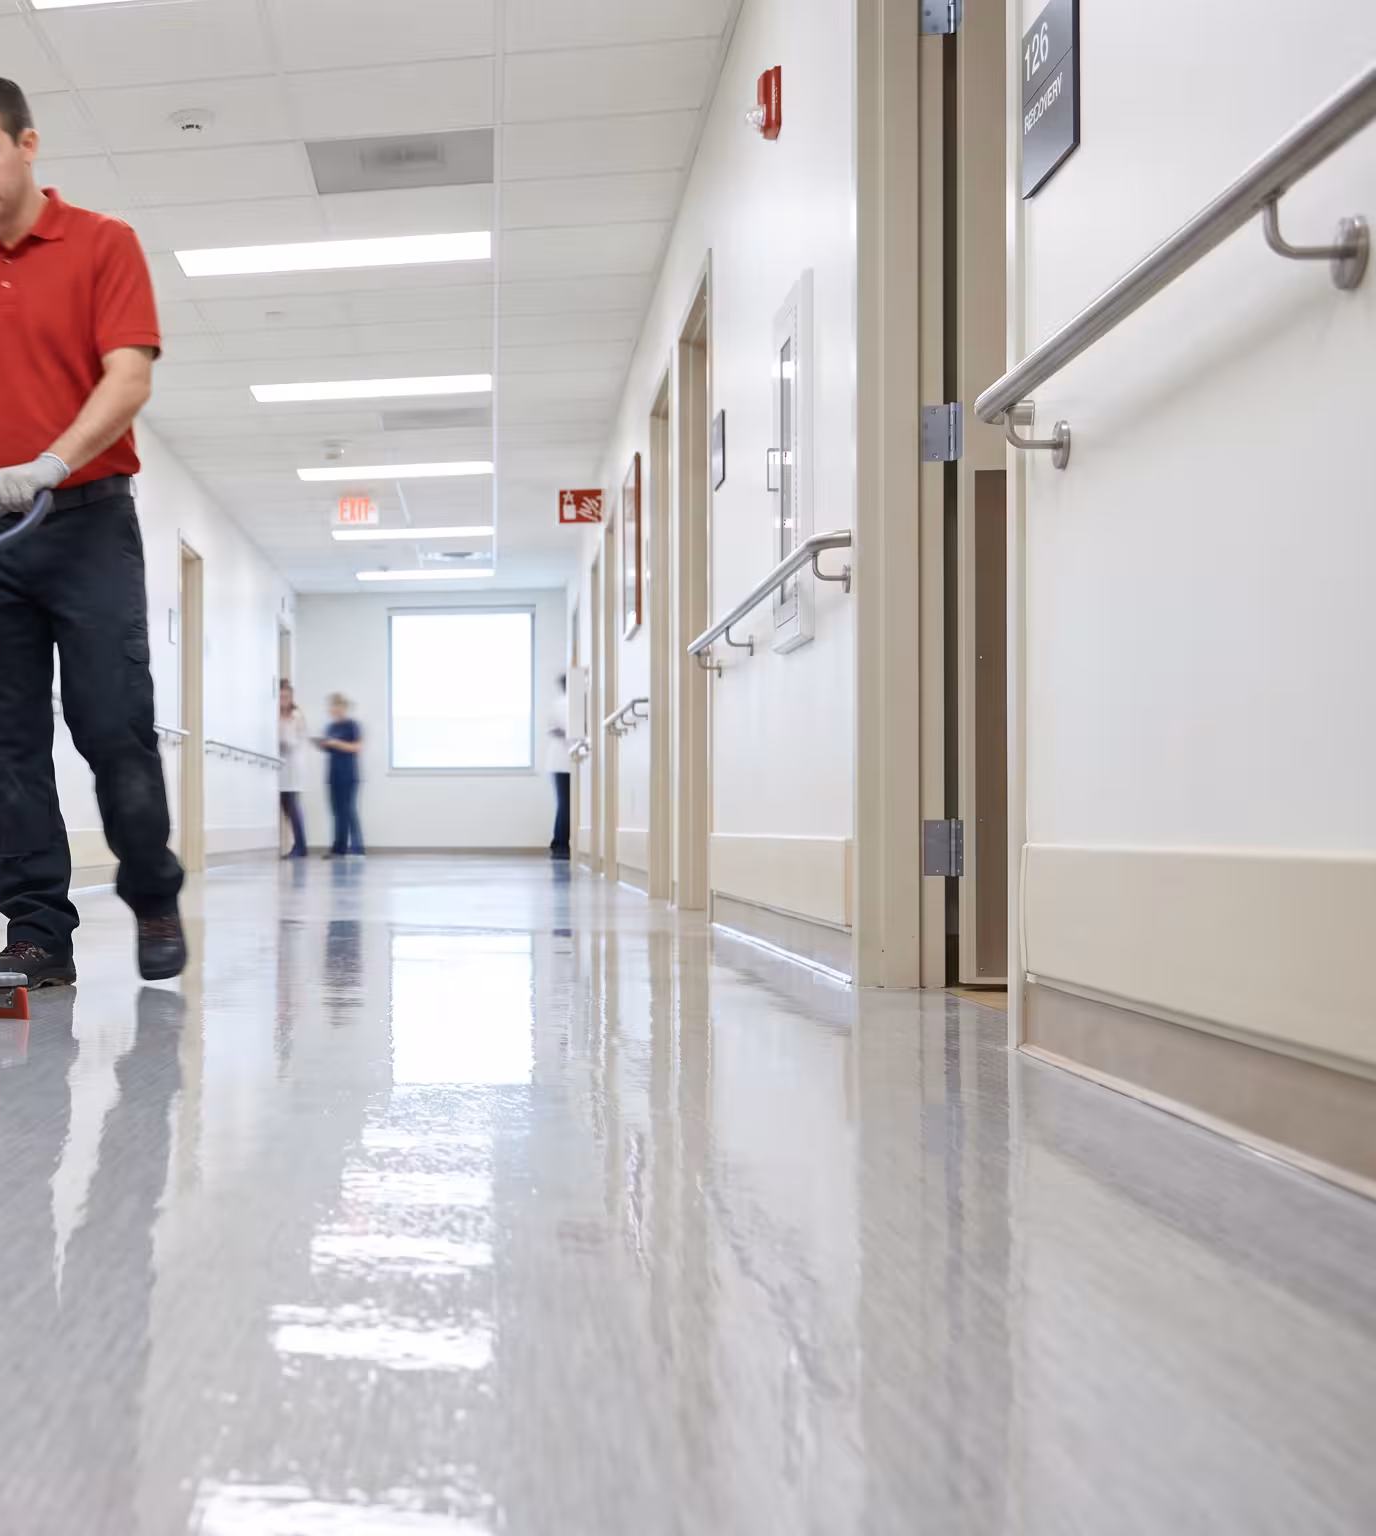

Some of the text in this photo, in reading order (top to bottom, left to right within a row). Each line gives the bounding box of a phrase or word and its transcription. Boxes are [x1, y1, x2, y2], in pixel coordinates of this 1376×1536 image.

[1024, 21, 1049, 82] 126
[1024, 71, 1063, 136] RECOVERY
[339, 498, 369, 522] EXIT
